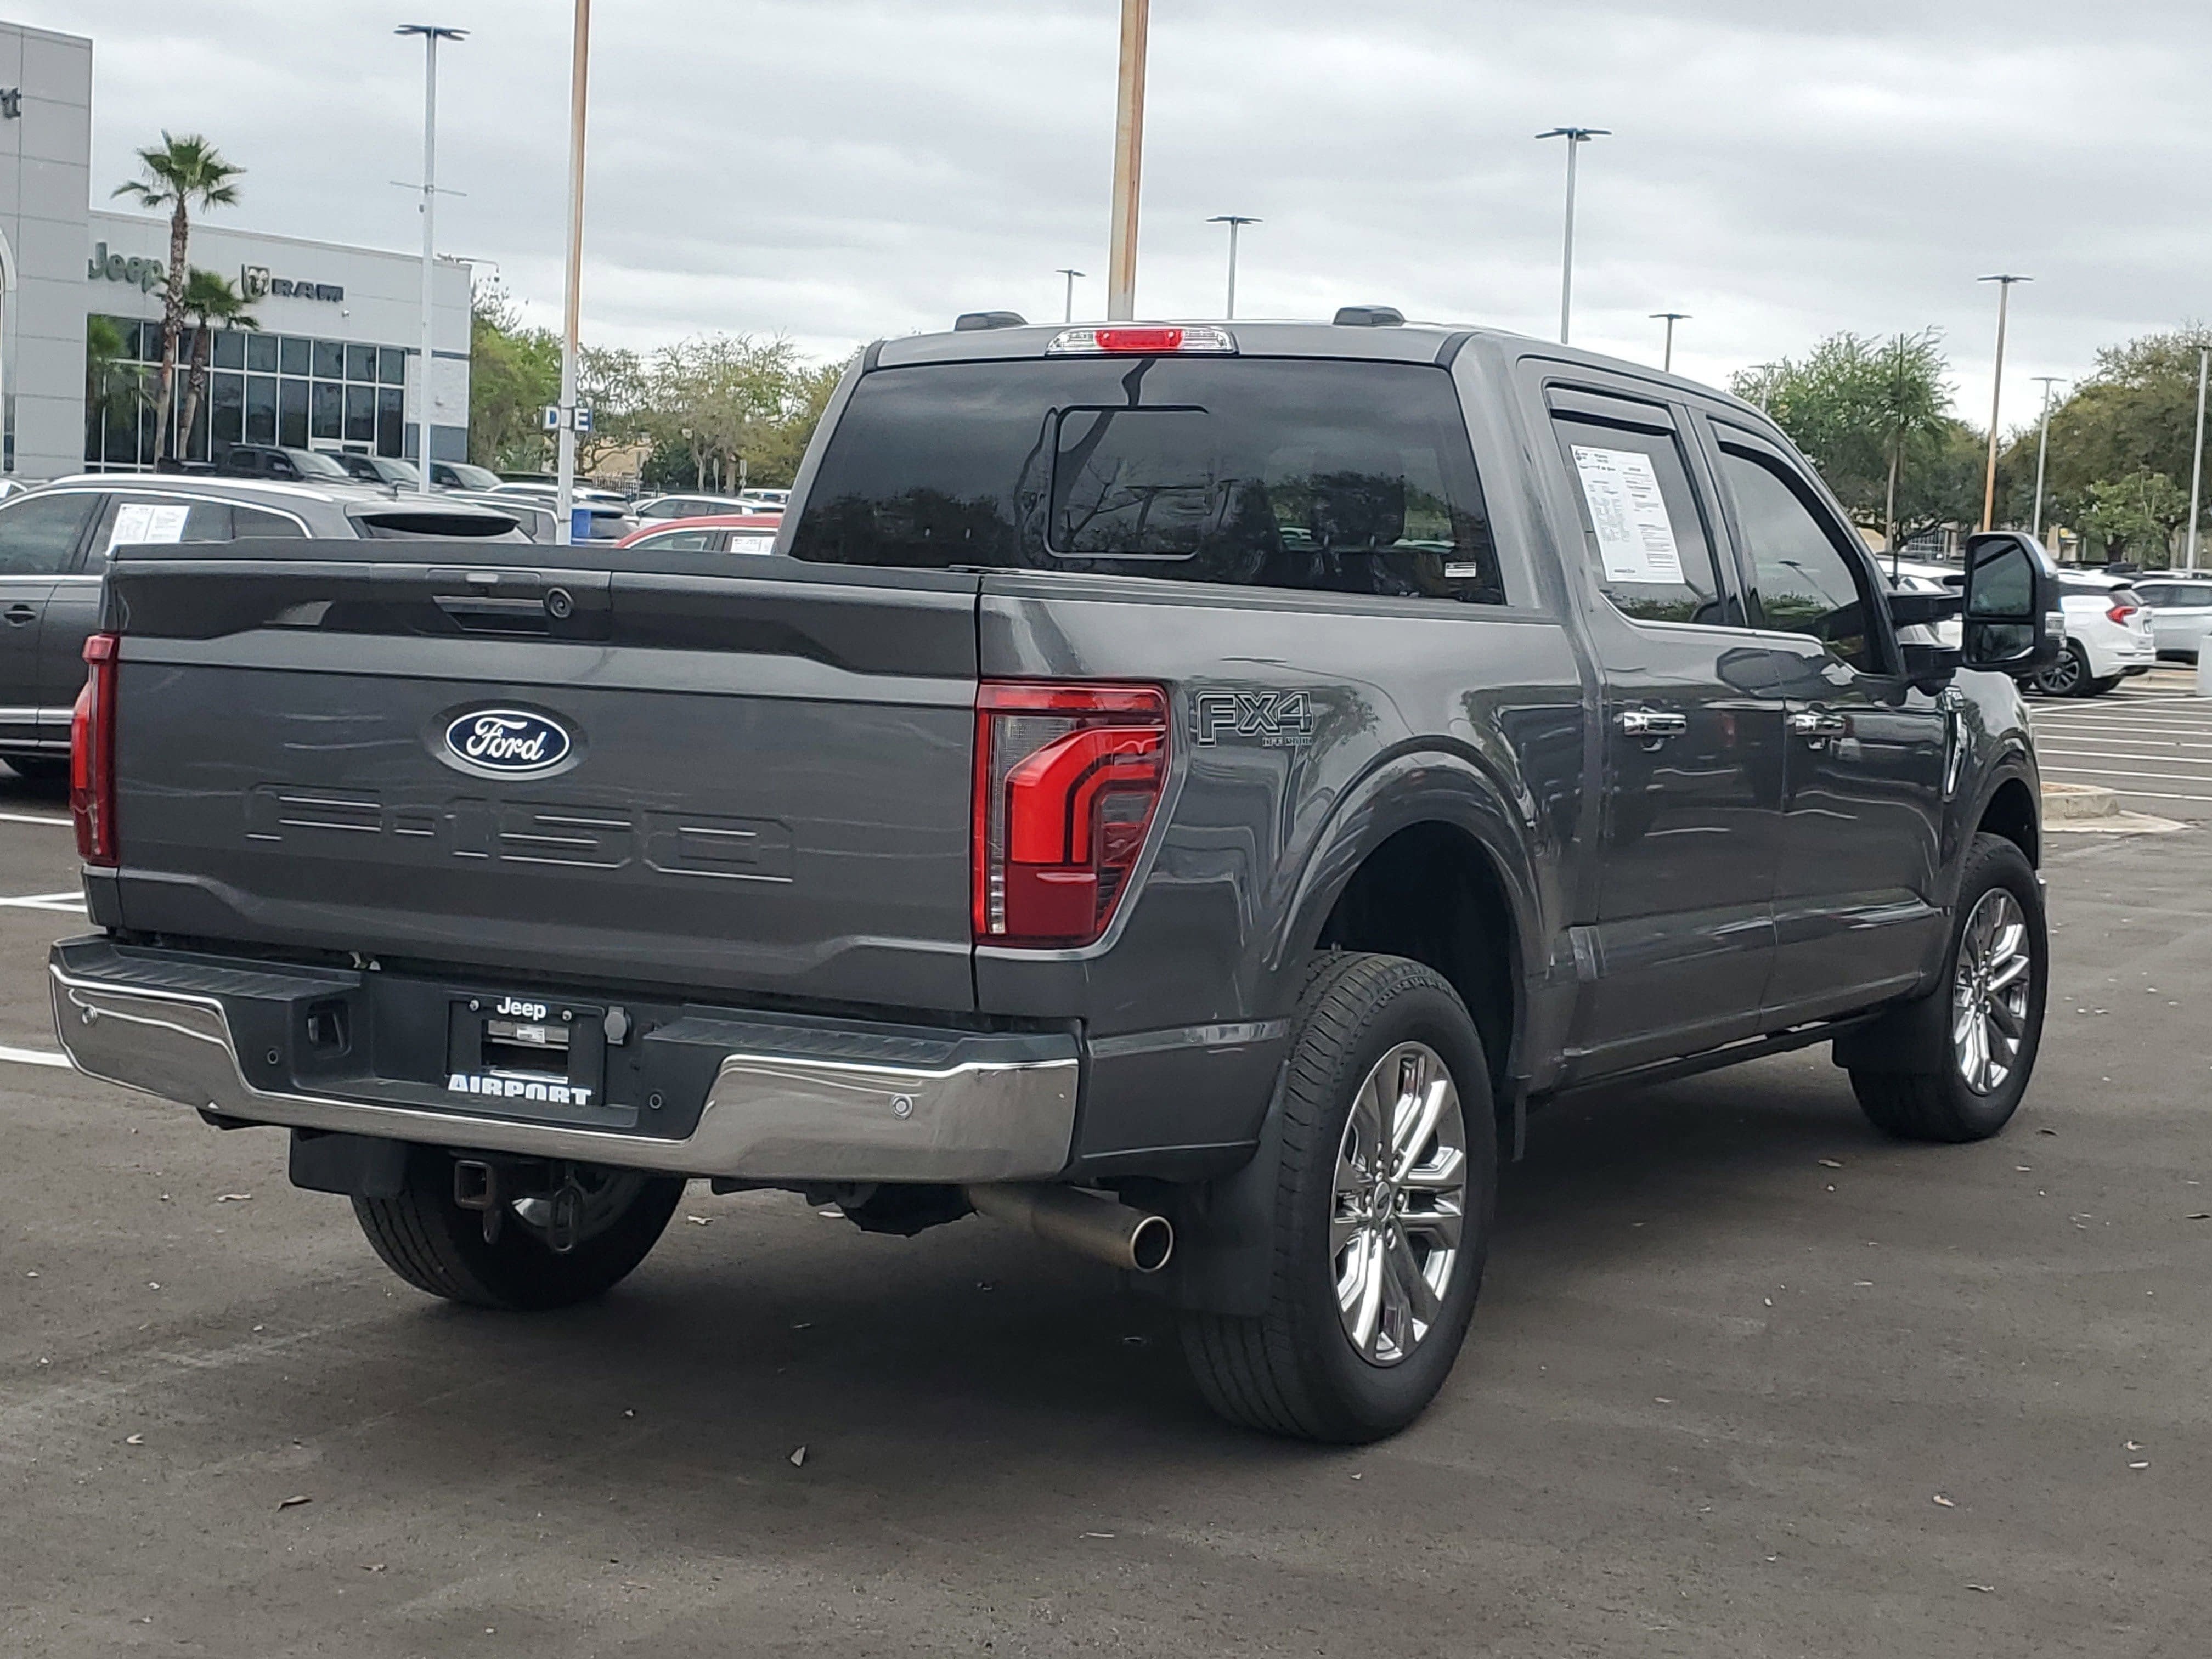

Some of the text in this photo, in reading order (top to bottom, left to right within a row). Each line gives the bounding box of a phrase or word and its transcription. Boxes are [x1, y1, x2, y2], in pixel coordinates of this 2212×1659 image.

[88, 242, 164, 294] Jeep
[271, 278, 343, 302] RAM
[466, 716, 547, 761] Ford
[1196, 691, 1313, 748] FX4
[245, 782, 793, 882] F-150
[496, 996, 546, 1021] Jeep
[448, 1073, 592, 1106] AIRPORT
